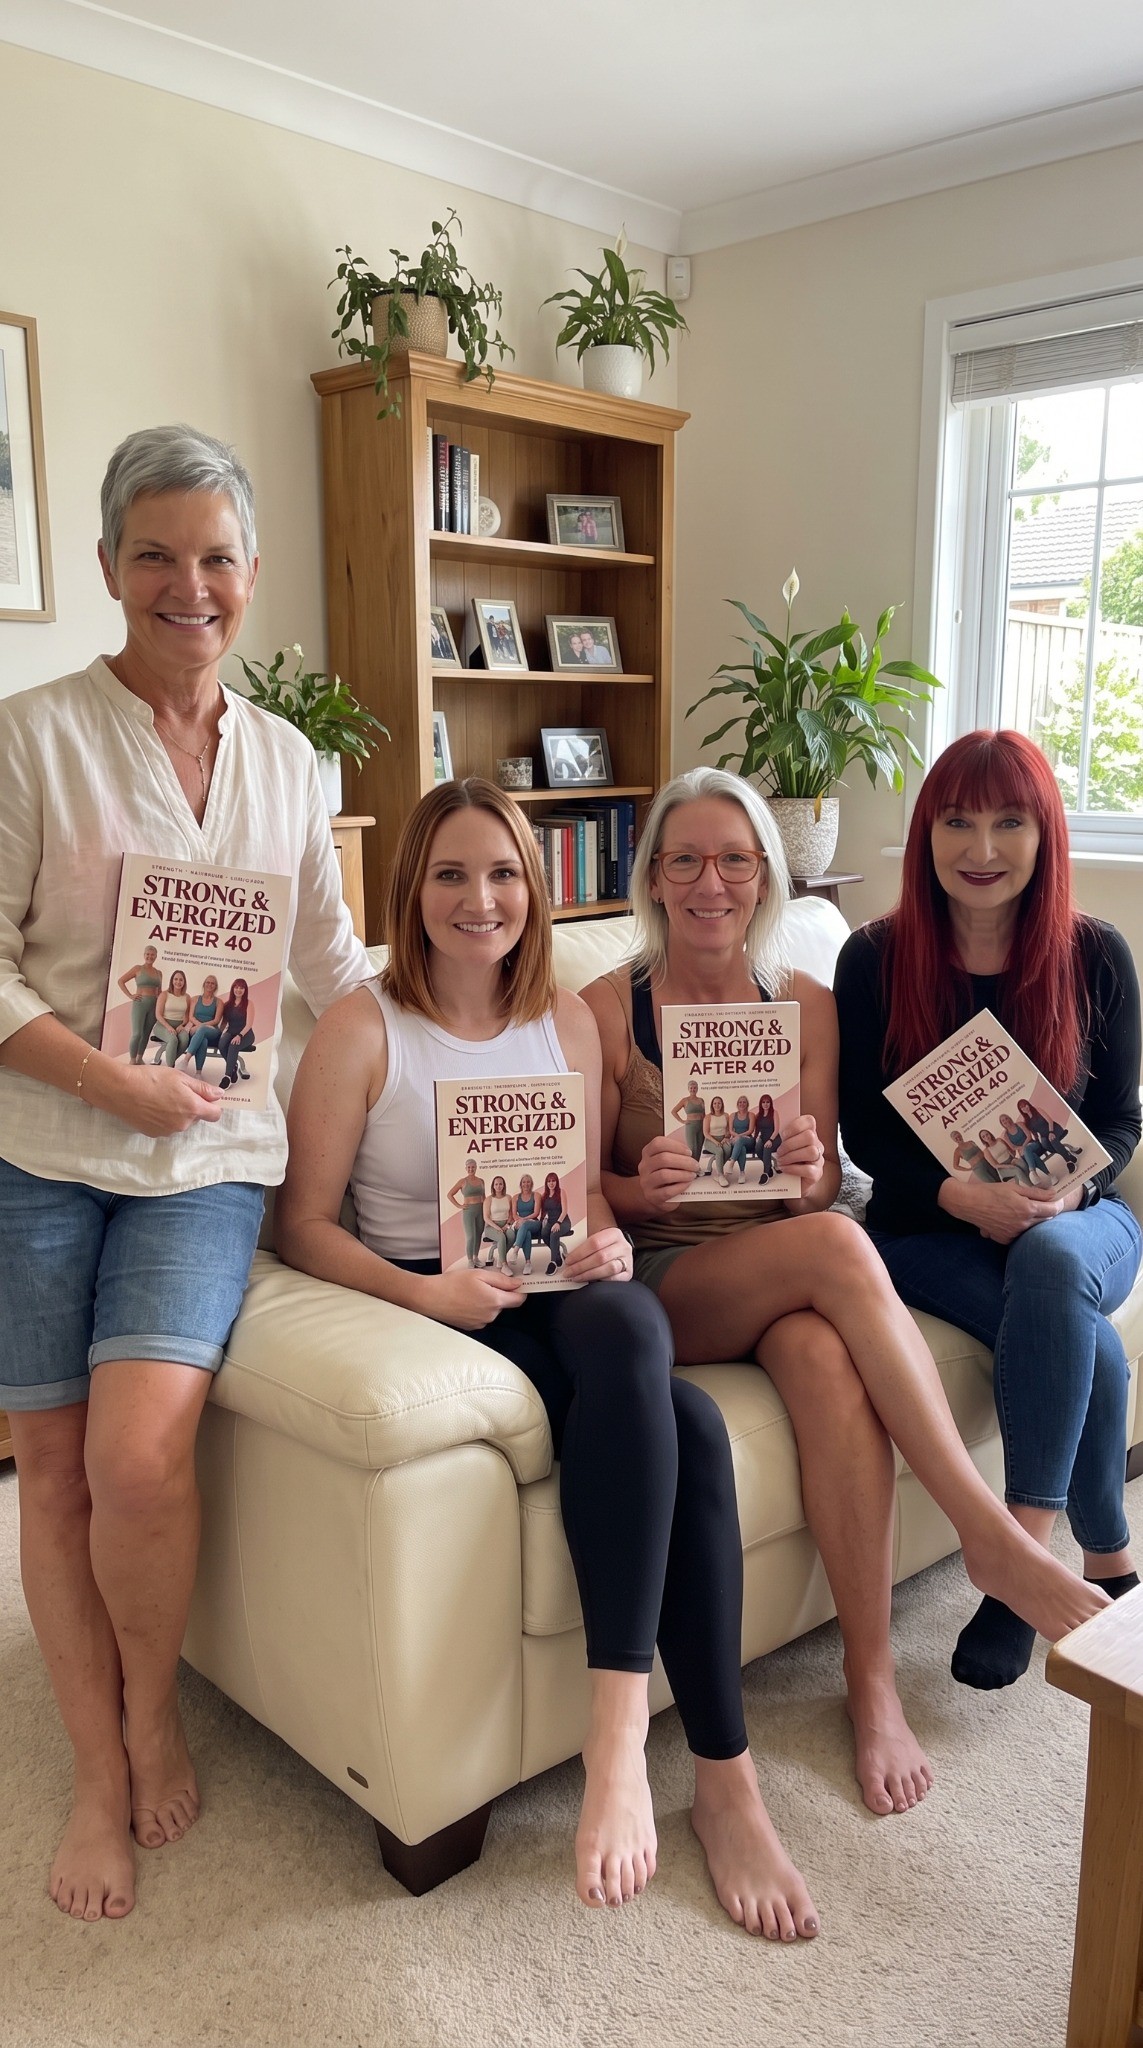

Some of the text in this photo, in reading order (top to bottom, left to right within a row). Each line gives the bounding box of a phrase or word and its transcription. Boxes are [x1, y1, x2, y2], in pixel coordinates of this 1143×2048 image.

[143, 874, 247, 908] STRONG
[251, 890, 270, 912] &
[130, 896, 276, 935] ENERGIZED
[148, 924, 252, 953] AFTER 40
[680, 1019, 783, 1039] STRONG &
[672, 1038, 792, 1059] ENERGIZED
[689, 1059, 775, 1076] AFTER 40
[906, 1043, 978, 1107] STRONG
[974, 1035, 994, 1053] &
[911, 1044, 1011, 1126] ENERGIZED
[455, 1091, 567, 1115] STRONG &
[940, 1087, 988, 1129] AFTER
[988, 1070, 1009, 1090] 40
[448, 1112, 576, 1136] ENERGIZED
[467, 1135, 558, 1154] AFTER 40
